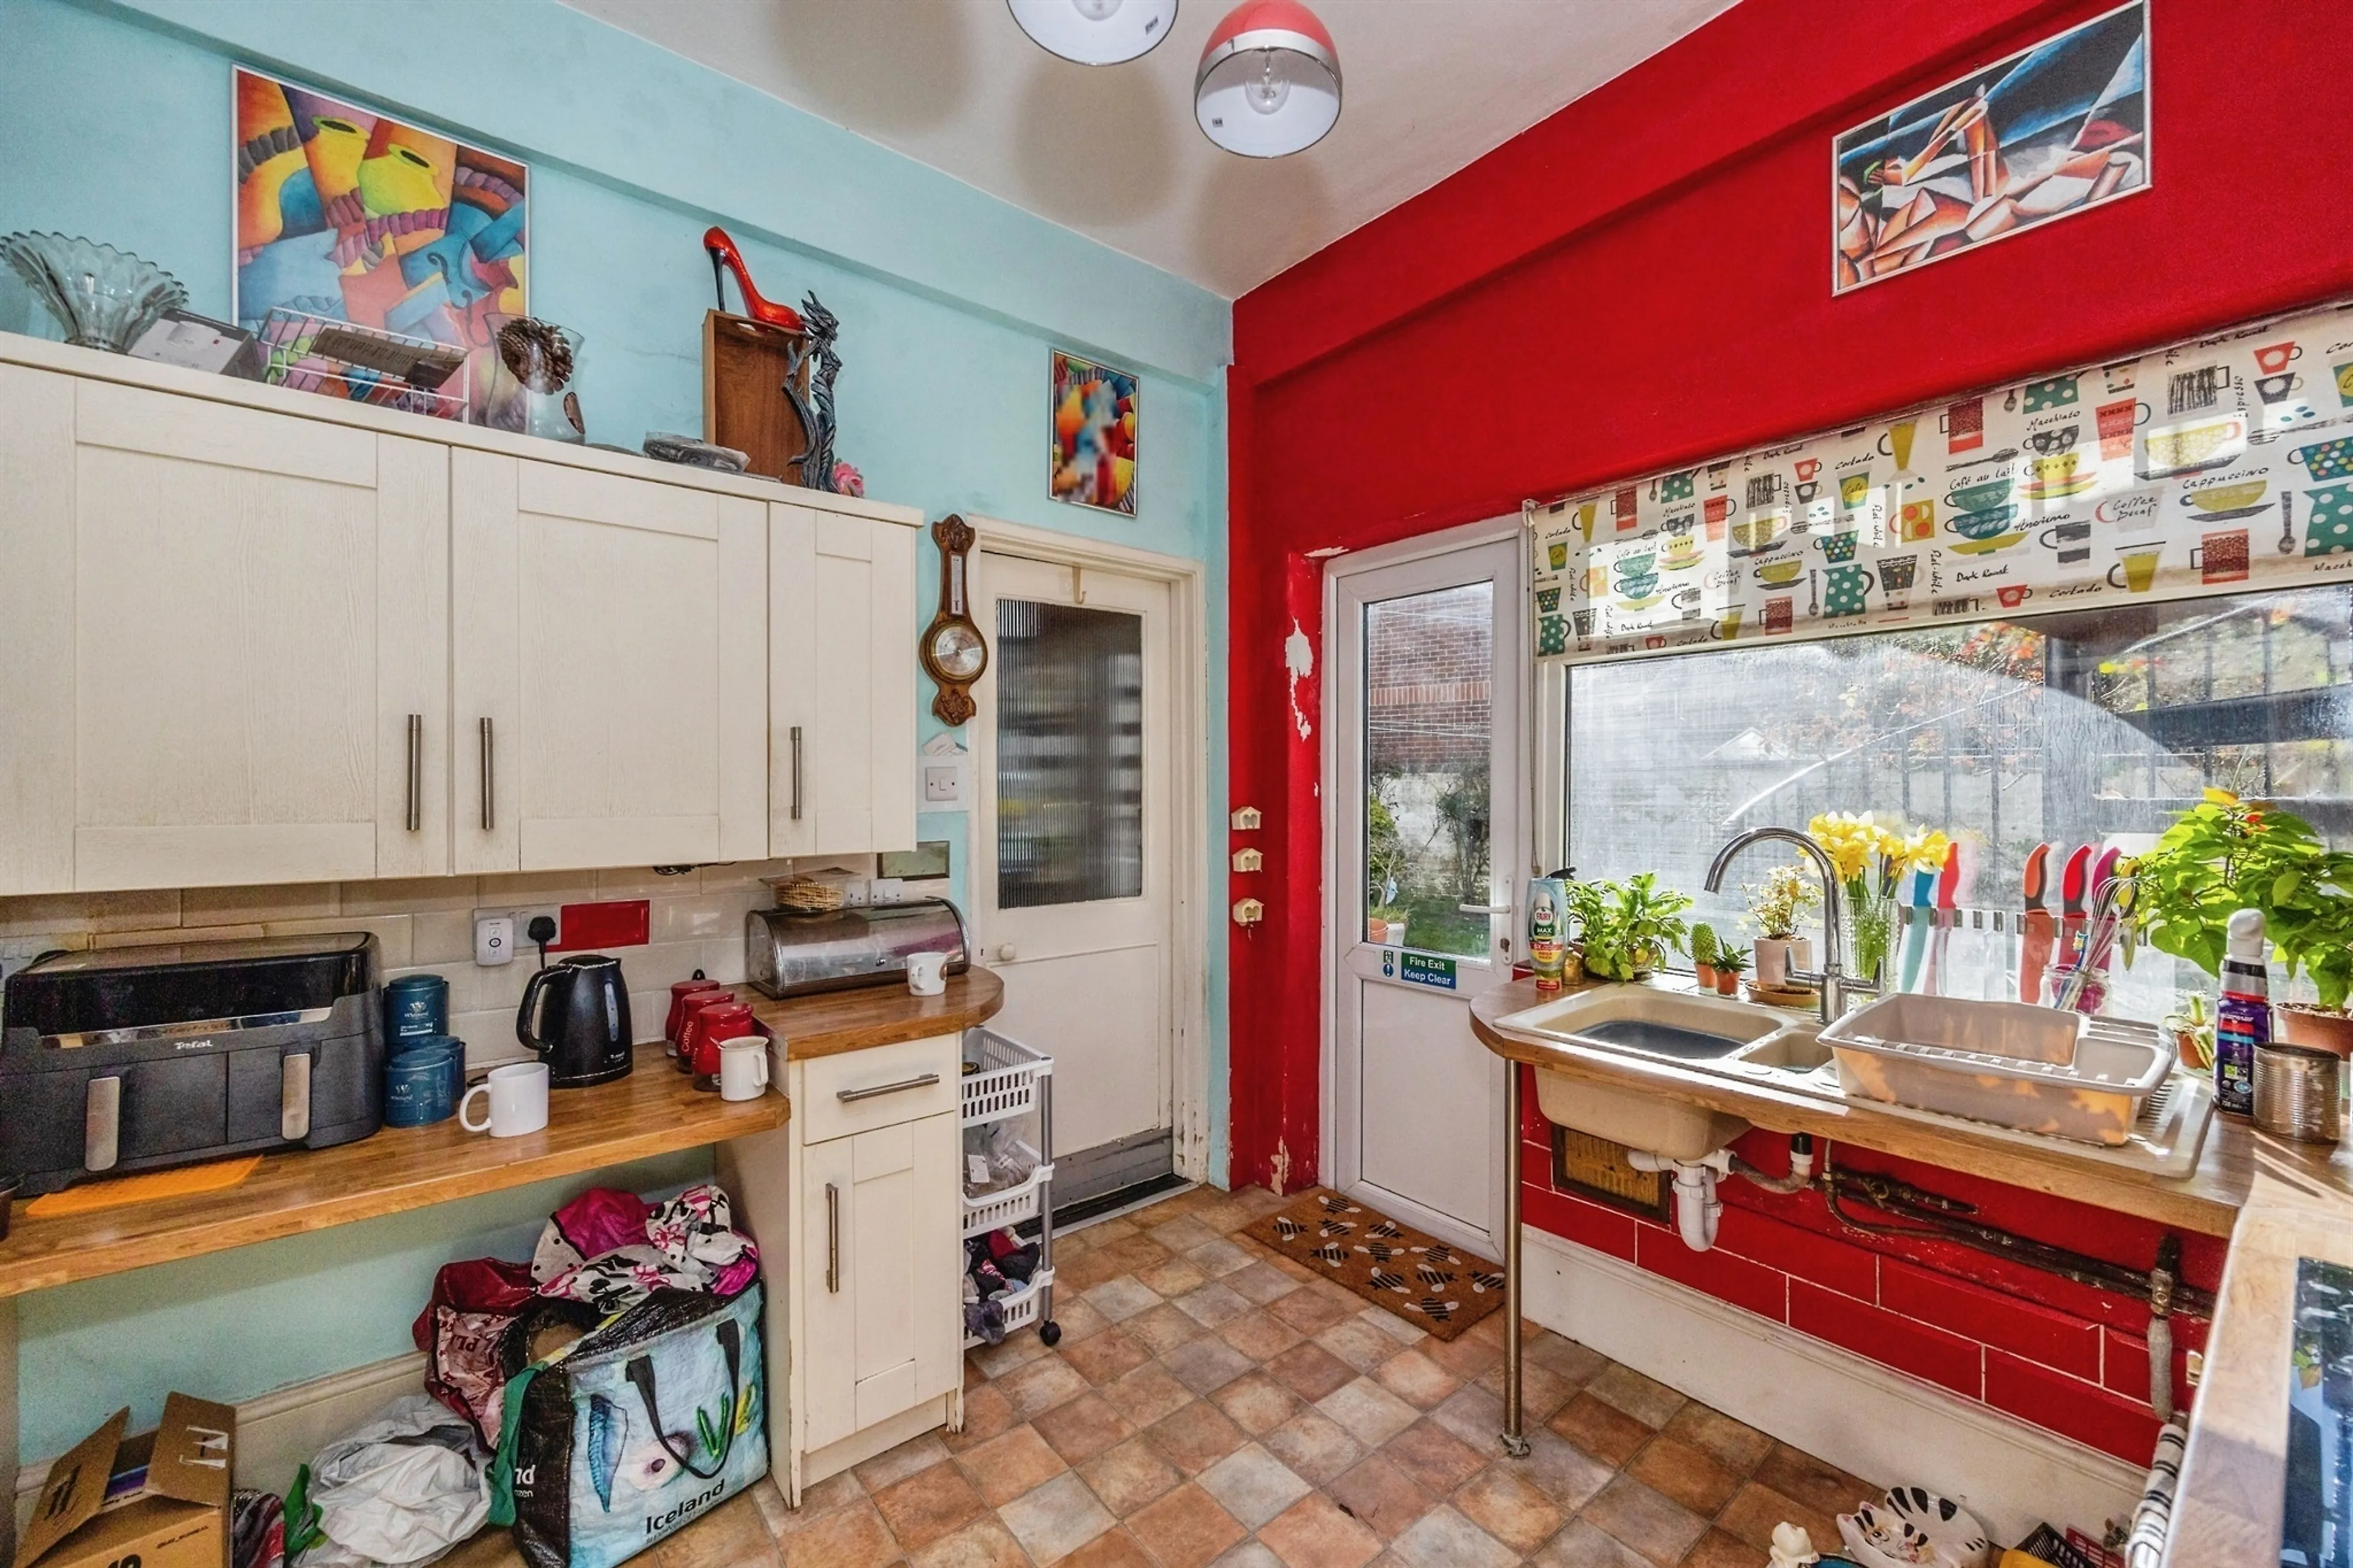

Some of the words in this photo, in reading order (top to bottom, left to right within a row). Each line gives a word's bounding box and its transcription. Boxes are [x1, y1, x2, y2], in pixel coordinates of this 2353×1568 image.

[1835, 452, 1874, 470] Cortado
[2049, 583, 2102, 598] Cortado
[1409, 956, 1426, 968] Fire
[1428, 960, 1445, 971] Exit
[1404, 969, 1426, 982] Keep
[1428, 973, 1451, 985] Clear
[174, 1039, 213, 1050] Tefal
[681, 1021, 694, 1052] Coffee
[646, 1478, 725, 1534] Iceland
